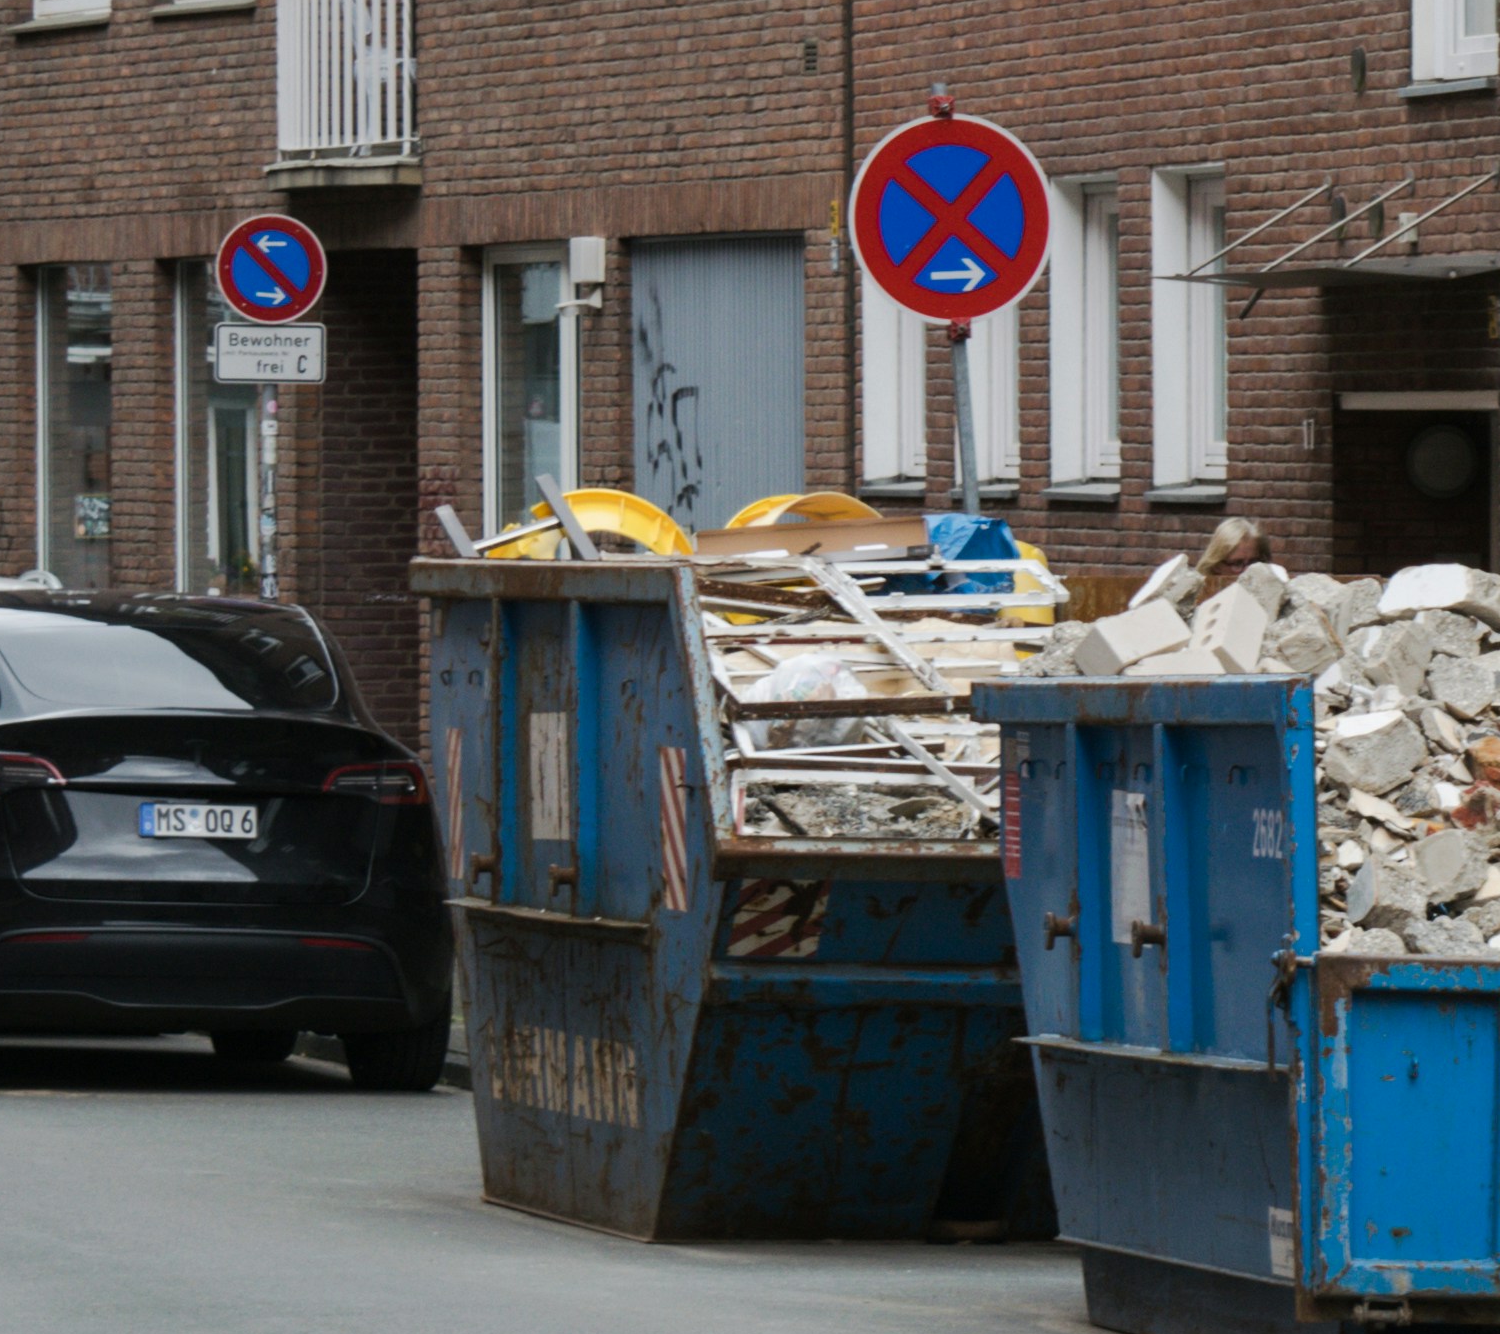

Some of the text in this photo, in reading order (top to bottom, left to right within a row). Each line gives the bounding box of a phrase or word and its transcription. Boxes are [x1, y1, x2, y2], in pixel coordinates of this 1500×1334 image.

[228, 332, 311, 347] Bewohner
[256, 354, 308, 374] frei C
[156, 808, 253, 834] MS OQ 6
[1252, 807, 1283, 859] 2682
